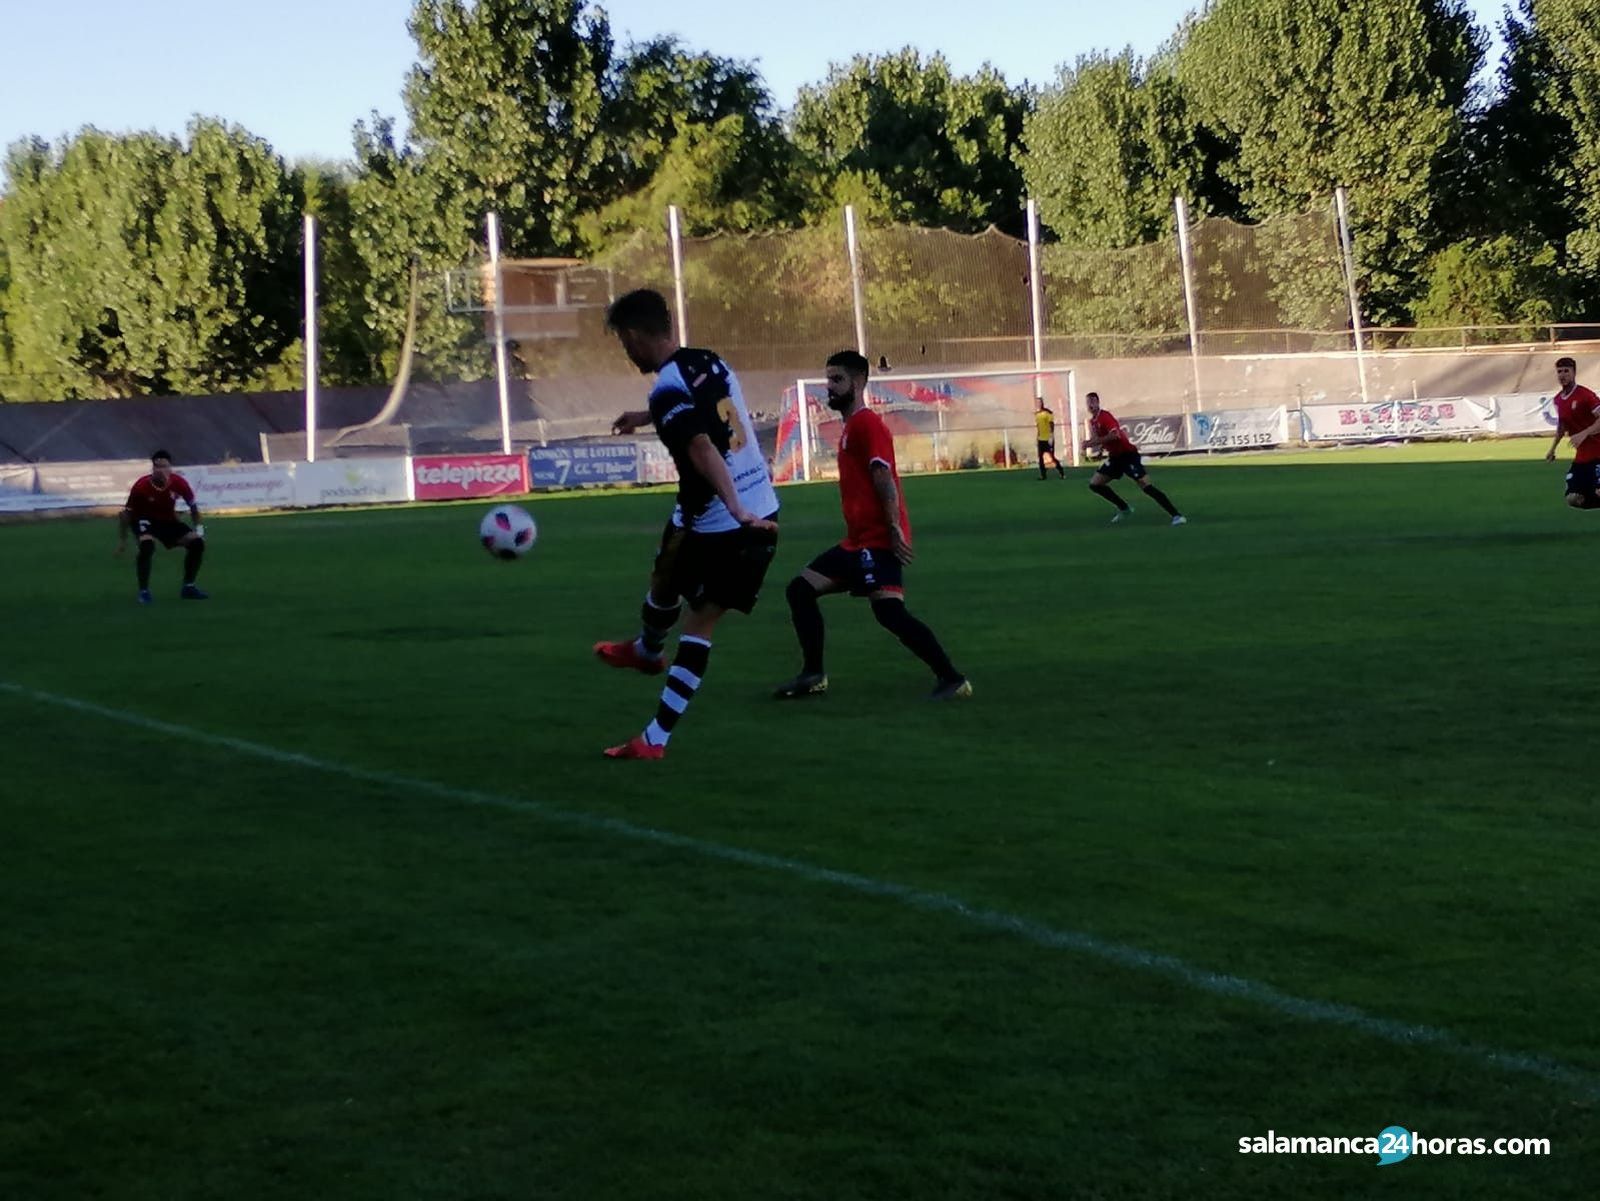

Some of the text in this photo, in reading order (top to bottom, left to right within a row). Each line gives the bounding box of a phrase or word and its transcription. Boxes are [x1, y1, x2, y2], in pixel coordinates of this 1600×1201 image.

[1231, 434, 1250, 445] 155
[1253, 432, 1272, 443] 152
[415, 463, 521, 490] telepizza
[555, 460, 571, 484] 7
